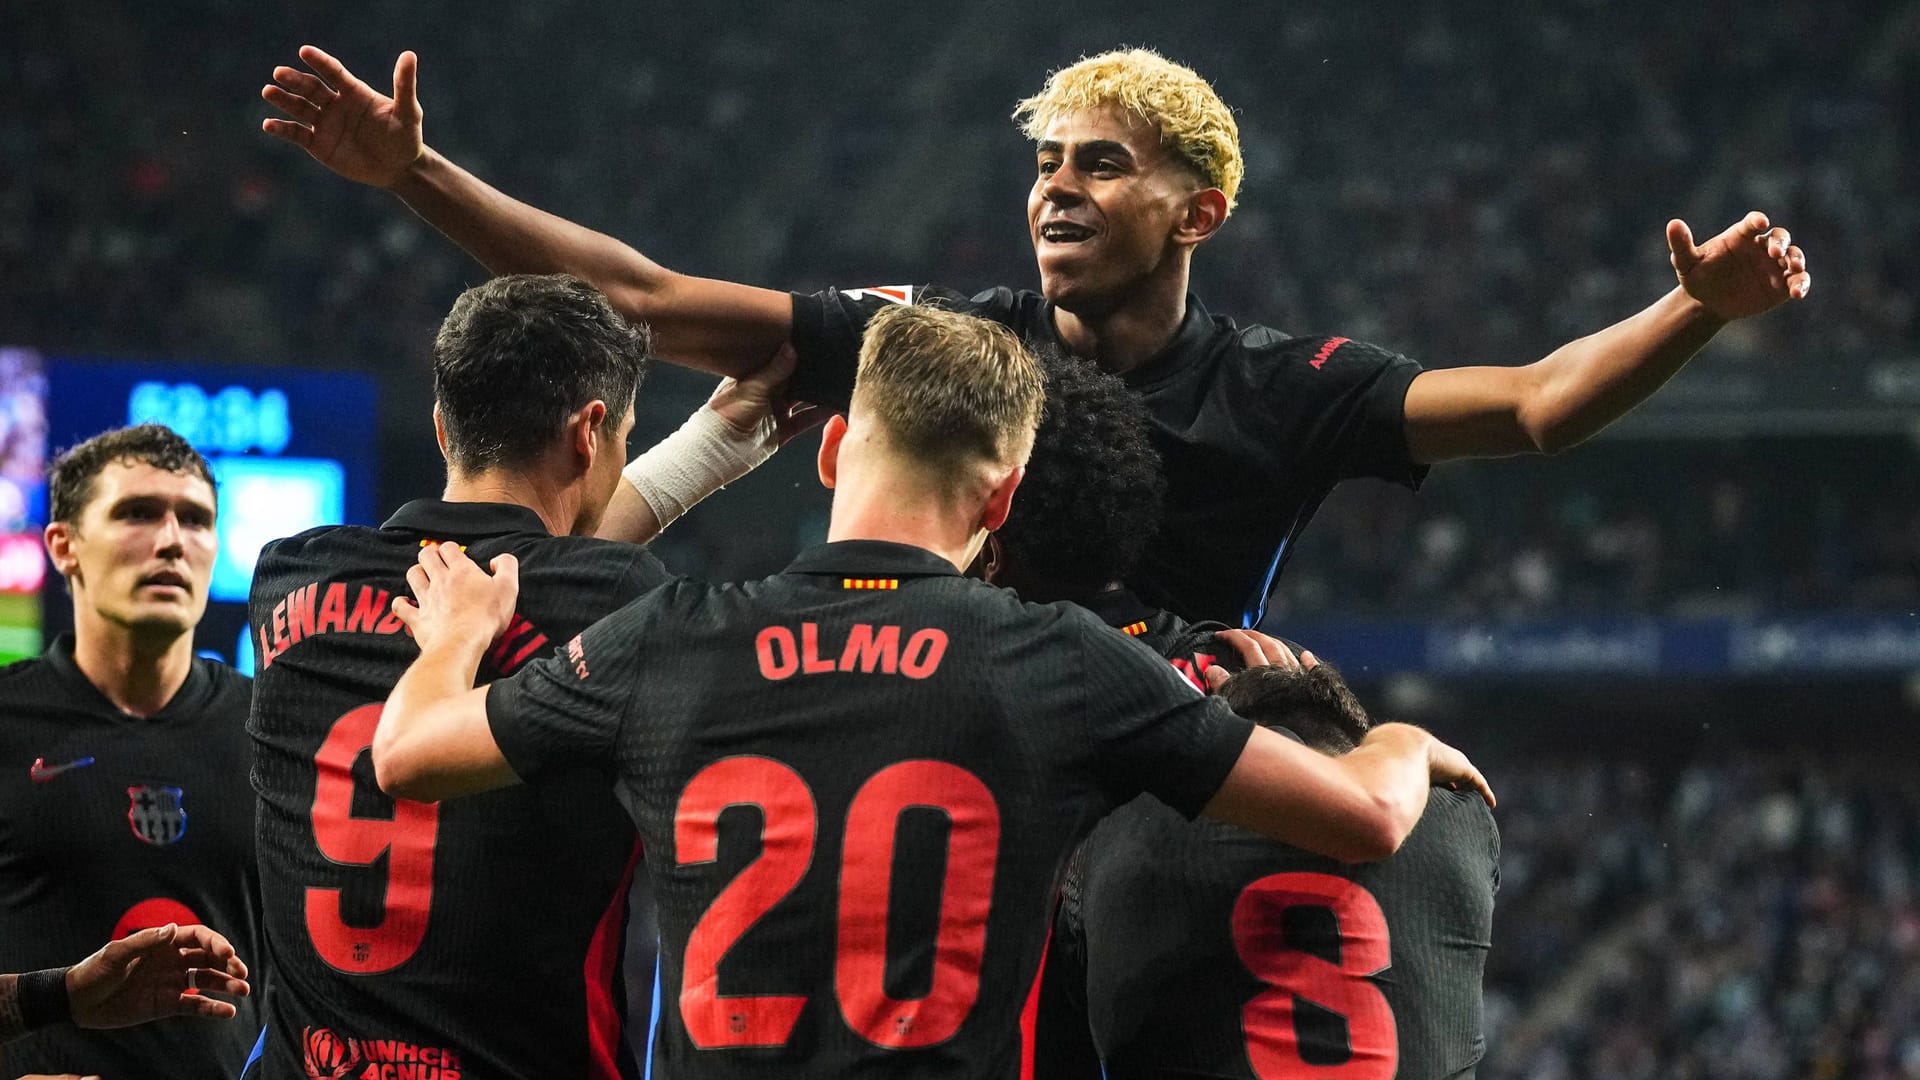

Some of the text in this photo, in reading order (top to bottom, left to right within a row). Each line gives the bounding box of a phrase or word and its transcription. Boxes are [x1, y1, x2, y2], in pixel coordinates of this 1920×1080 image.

[755, 622, 949, 681] OLMO
[304, 702, 441, 975] 9
[674, 755, 1001, 1050] 20
[361, 1039, 461, 1069] UNHCR
[1232, 871, 1399, 1080] 8
